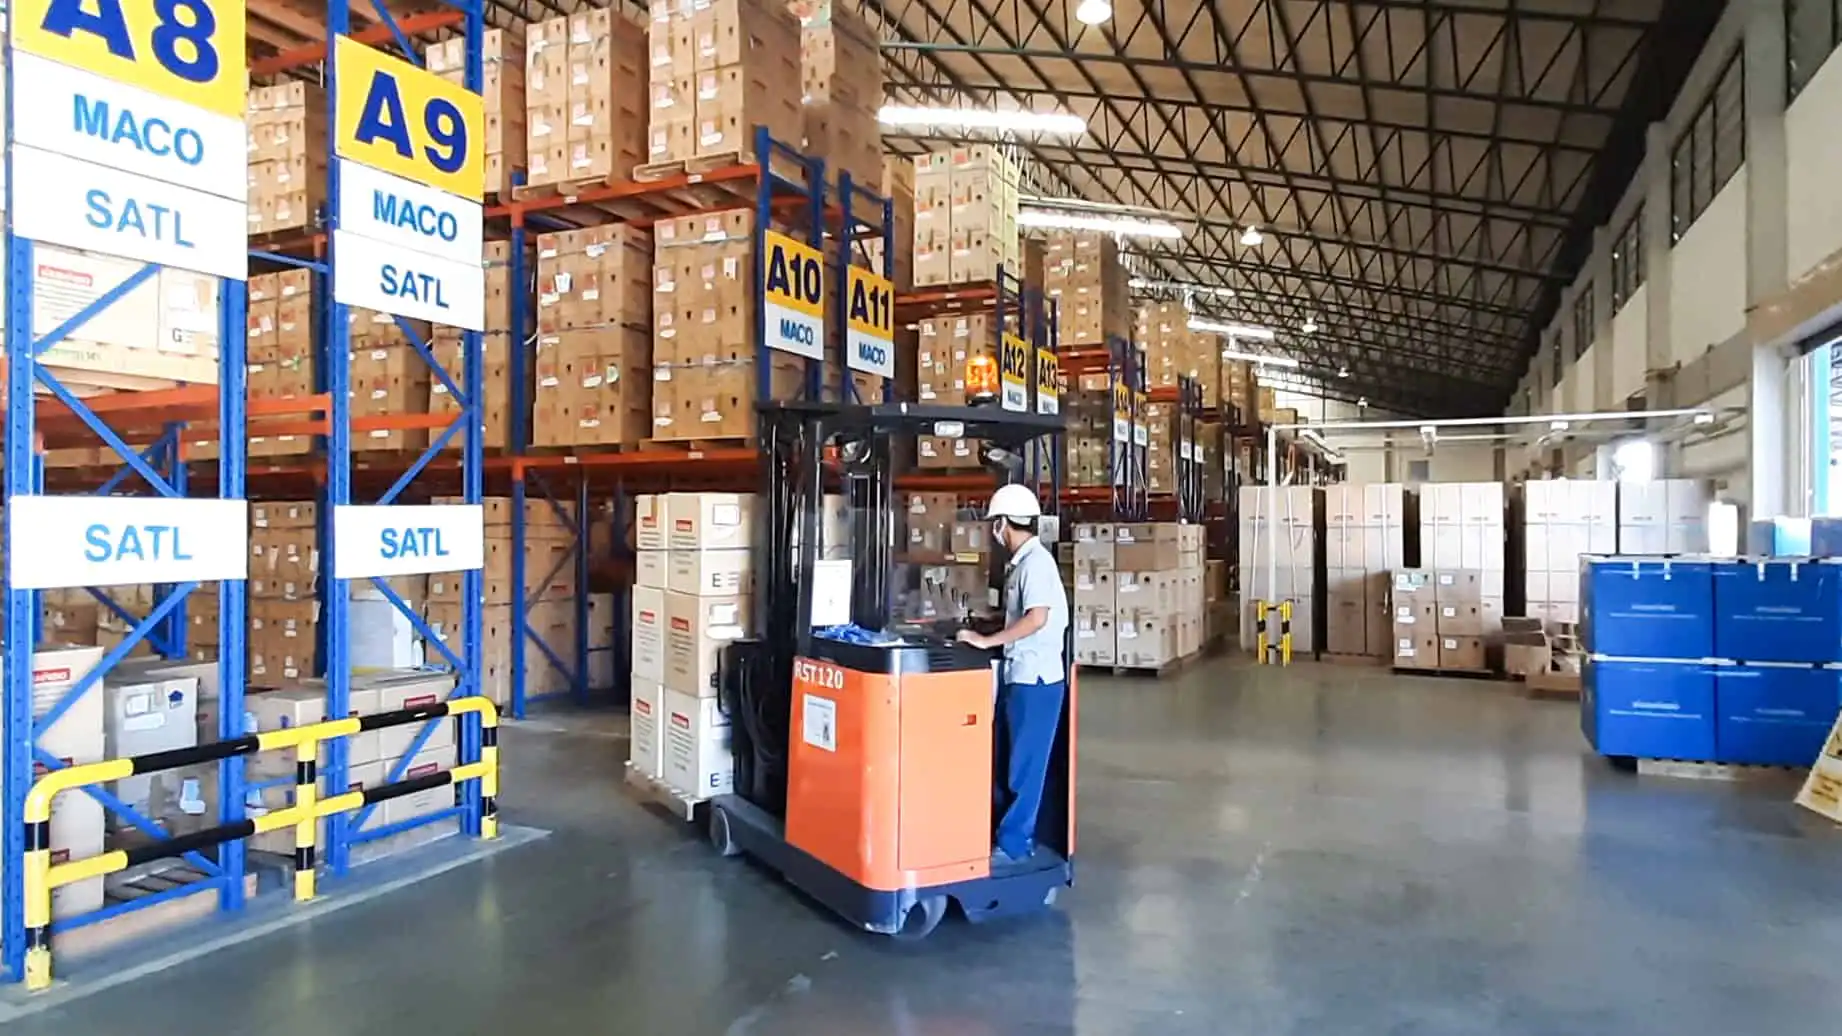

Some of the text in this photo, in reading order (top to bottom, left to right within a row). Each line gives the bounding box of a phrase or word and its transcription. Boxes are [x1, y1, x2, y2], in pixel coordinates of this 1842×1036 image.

[41, 0, 219, 83] A8
[73, 93, 204, 165] MACO
[355, 70, 467, 173] A9
[85, 189, 195, 248] SATL
[373, 189, 457, 242] MACO
[380, 264, 450, 308] SATL
[767, 245, 821, 304] A10
[850, 278, 889, 331] A11
[780, 318, 813, 345] MACO
[858, 341, 886, 366] MACO
[1003, 342, 1025, 379] A12
[84, 523, 193, 563] SATL
[380, 528, 450, 559] SATL
[712, 573, 721, 588] E
[710, 773, 720, 788] E
